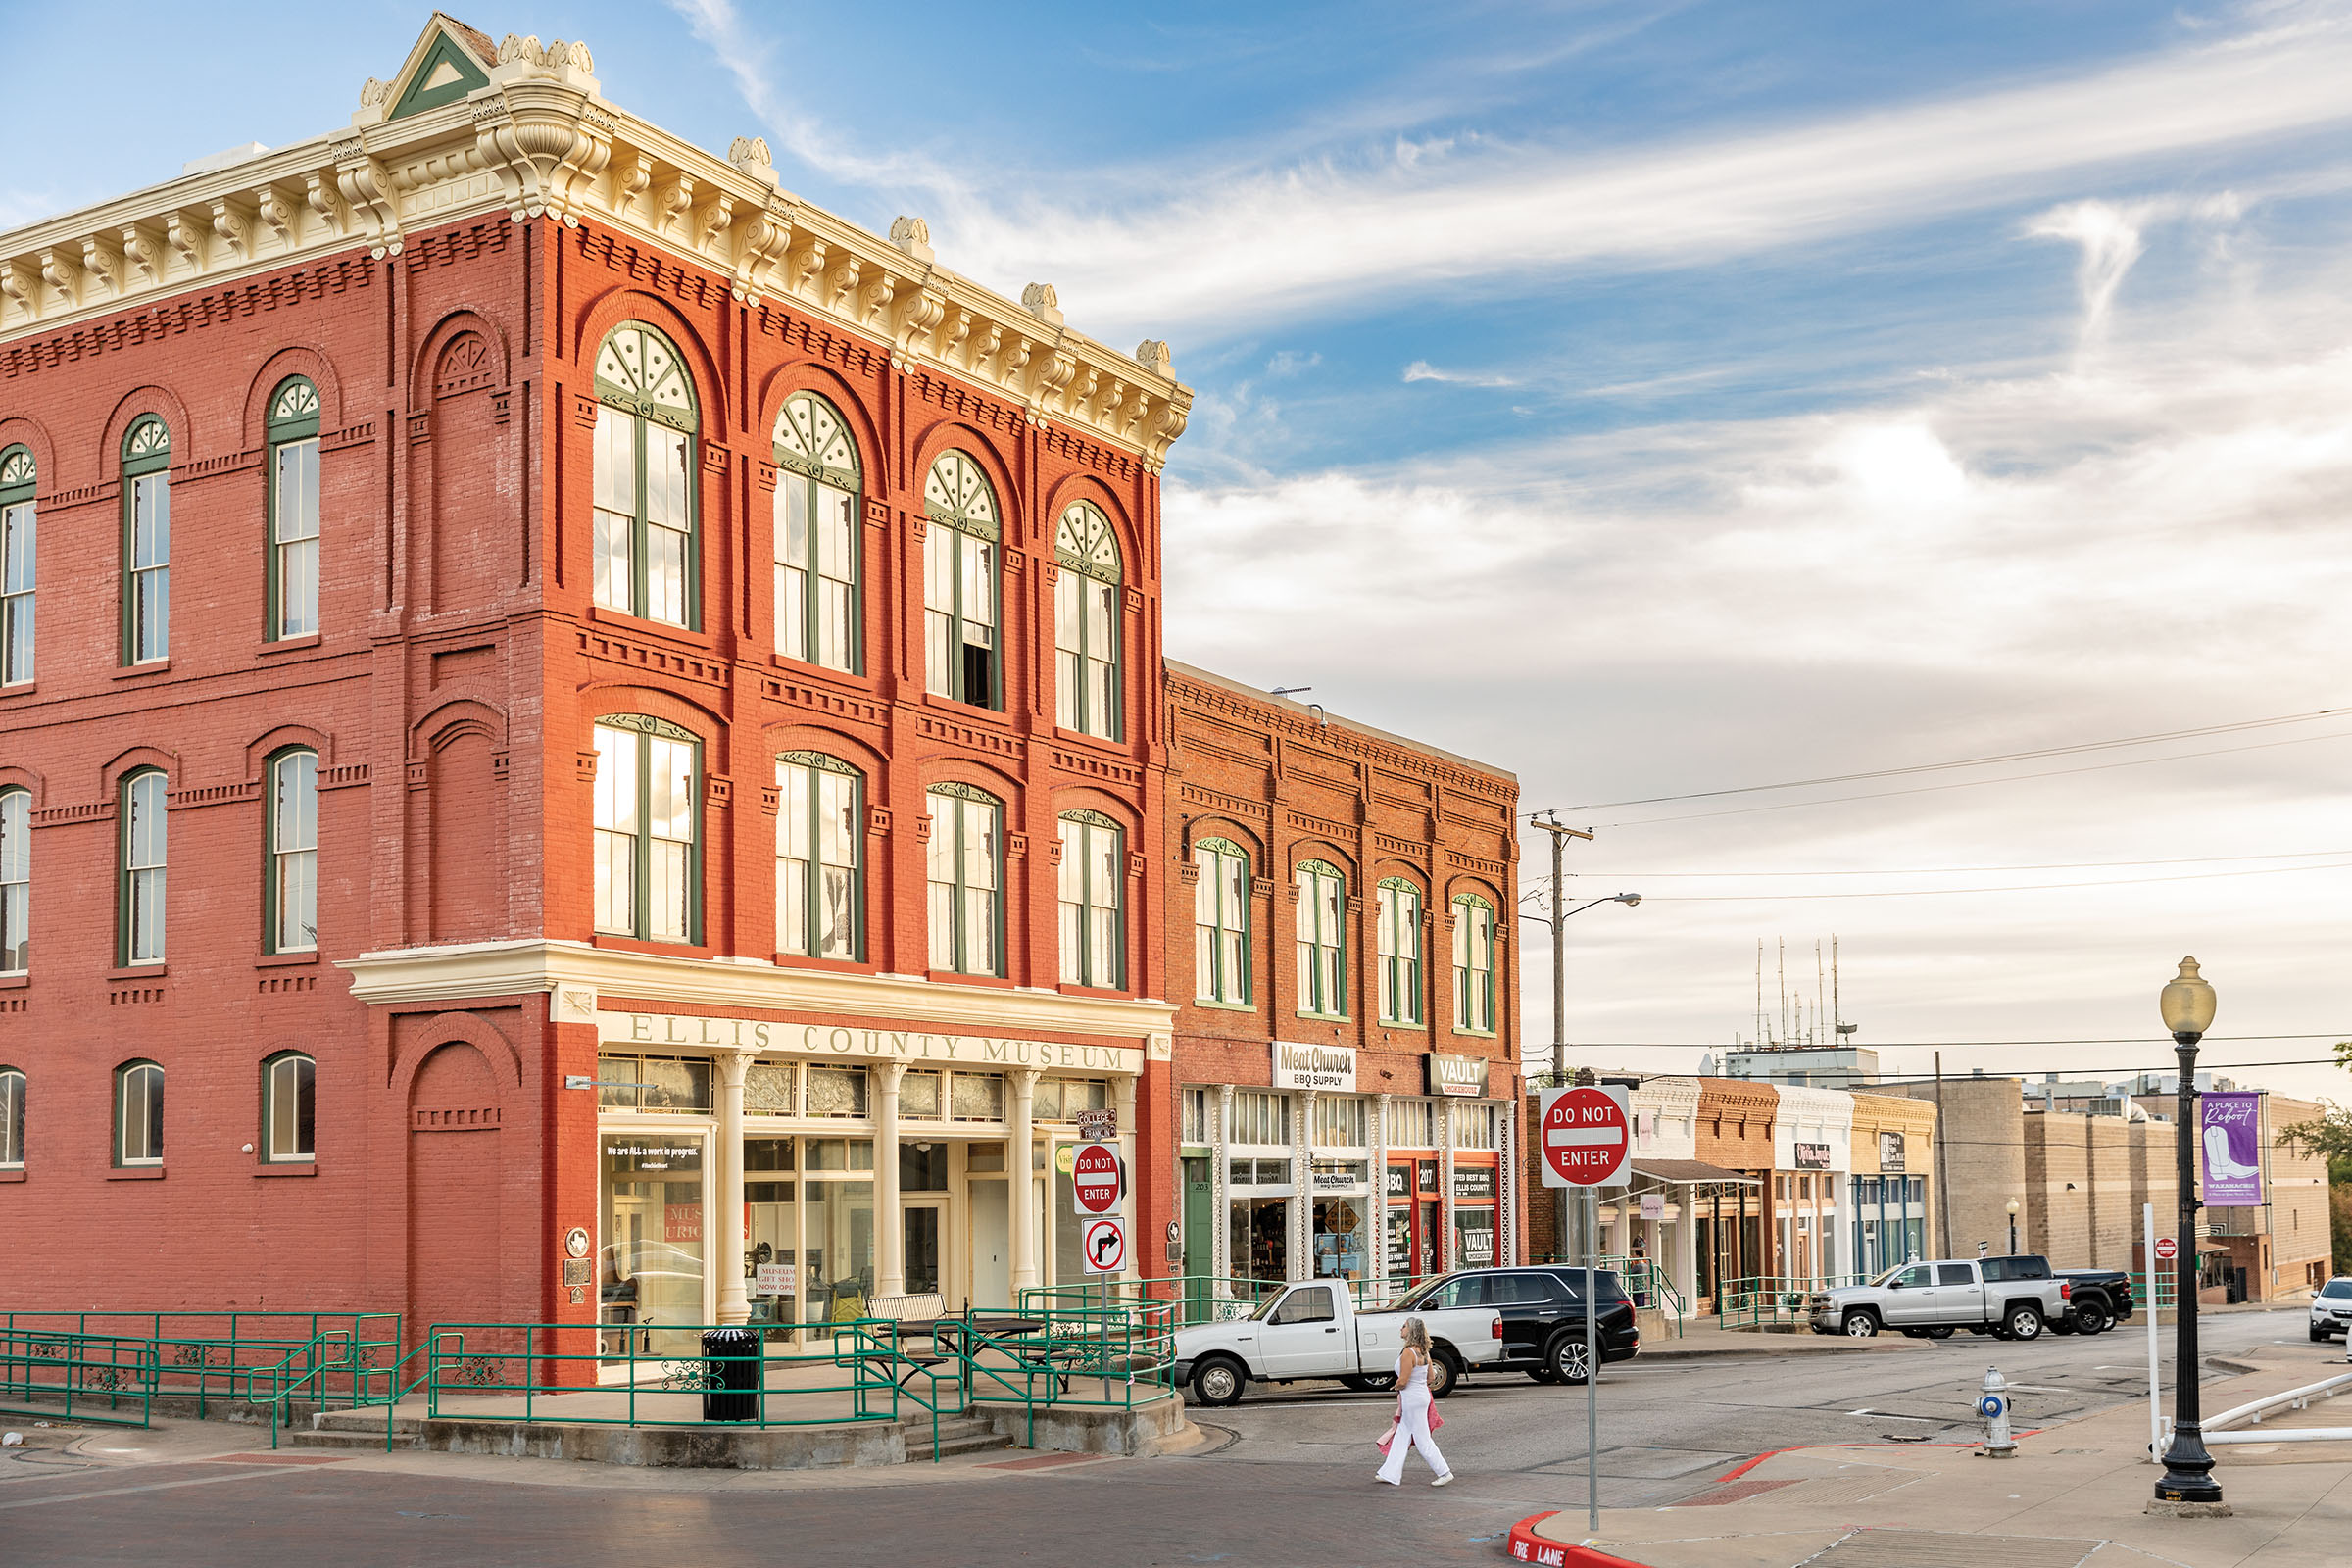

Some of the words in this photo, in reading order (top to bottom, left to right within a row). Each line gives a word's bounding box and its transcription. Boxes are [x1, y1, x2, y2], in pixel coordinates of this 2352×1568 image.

[630, 1014, 770, 1048] ELLIS
[803, 1025, 961, 1059] COUNTY
[983, 1039, 1123, 1070] MUSEUM
[1281, 1045, 1310, 1071] Meat
[1311, 1047, 1353, 1075] Church
[1439, 1060, 1480, 1083] VAULT
[1294, 1074, 1311, 1087] BBQ
[1313, 1076, 1343, 1086] SUPPLY
[1079, 1113, 1110, 1124] COLLEGE
[1553, 1108, 1575, 1124] DO
[1582, 1106, 1613, 1122] NOT
[2205, 1107, 2258, 1126] Reboot
[1084, 1128, 1110, 1138] FRANKLIN
[608, 1147, 616, 1155] We
[629, 1147, 642, 1155] ALL
[648, 1147, 663, 1155] work
[664, 1147, 670, 1155] in
[671, 1148, 698, 1158] progress.
[1058, 1155, 1072, 1164] Visit
[1561, 1151, 1609, 1166] ENTER
[1079, 1158, 1092, 1170] DO
[1095, 1157, 1111, 1169] NOT
[1313, 1175, 1330, 1184] Meat
[1330, 1175, 1354, 1185] Church
[1419, 1169, 1432, 1184] 207
[1084, 1189, 1110, 1200] ENTER
[670, 1207, 703, 1221] MUS
[1464, 1234, 1494, 1250] VAULT
[1513, 1540, 1530, 1559] FIRE
[1536, 1545, 1565, 1567] LANE
